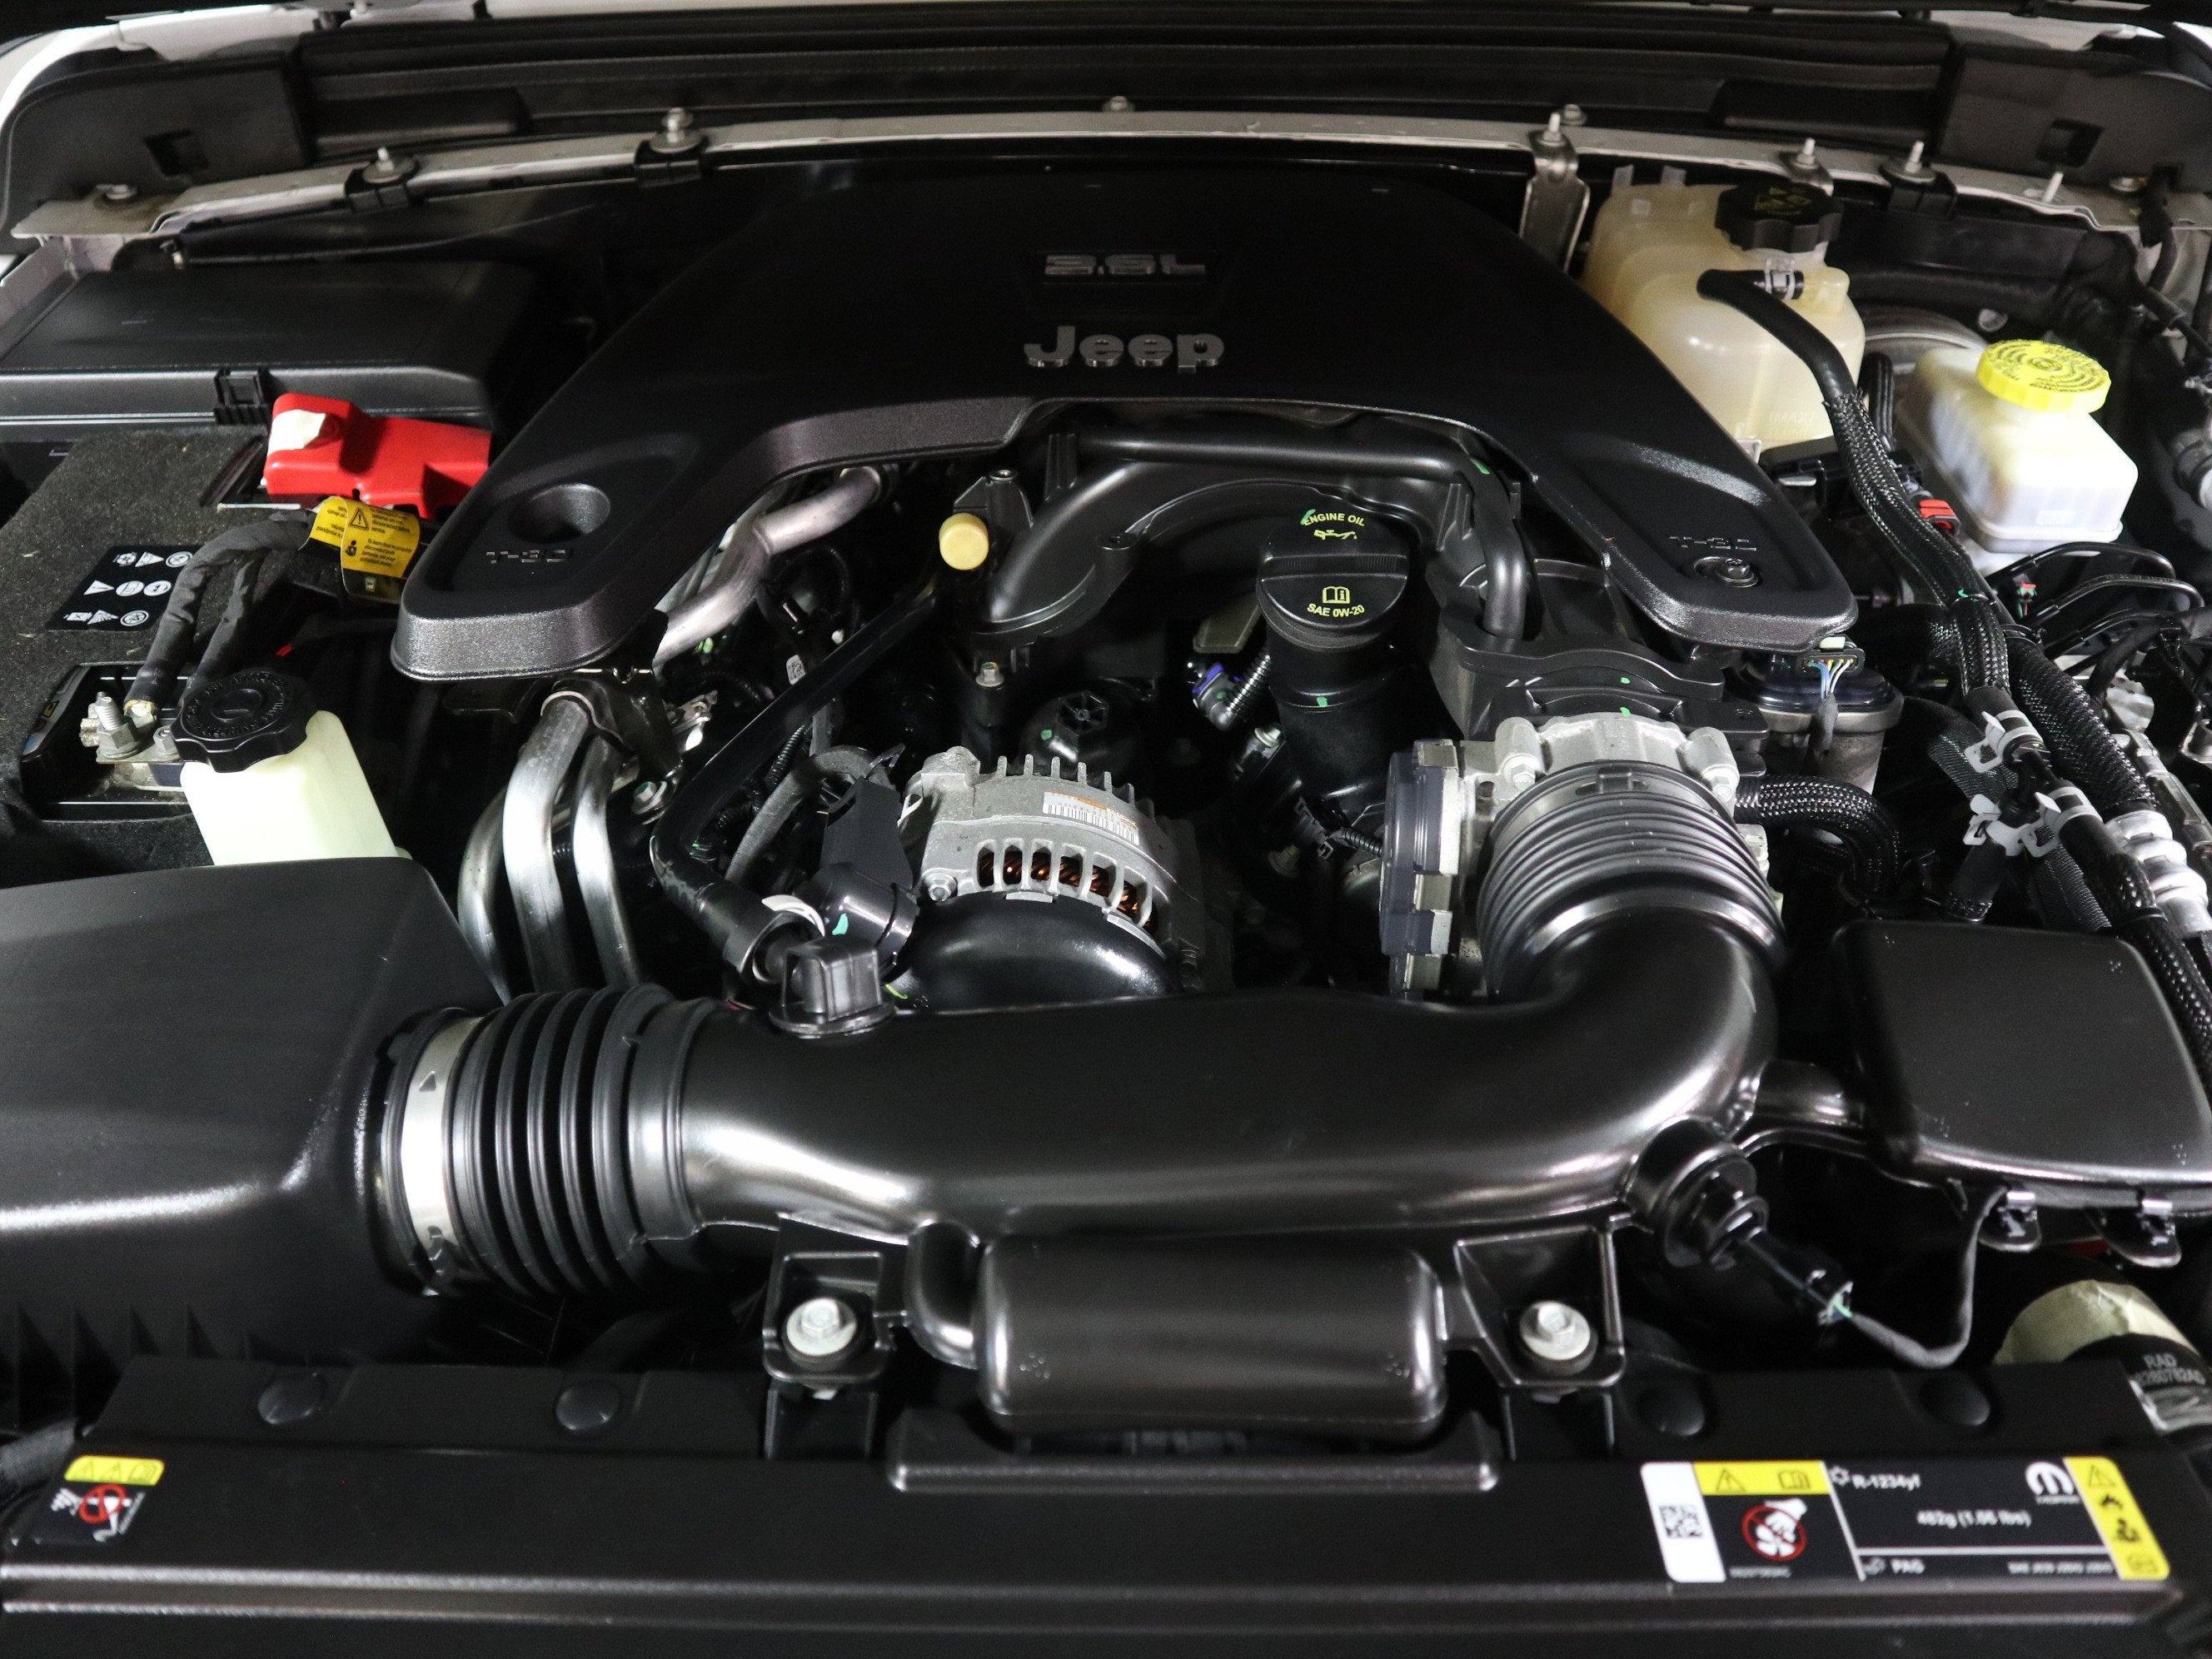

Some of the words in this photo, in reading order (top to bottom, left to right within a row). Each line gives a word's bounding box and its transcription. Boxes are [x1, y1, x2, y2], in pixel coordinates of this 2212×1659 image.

[1044, 252, 1207, 276] 3.6L
[1023, 325, 1225, 374] Jeep
[1303, 513, 1345, 526] ENGINE
[1348, 515, 1365, 526] OIL
[1308, 603, 1331, 616] SAE
[1333, 605, 1365, 617] 0W-20
[1851, 1472, 1921, 1492] R-1234yf
